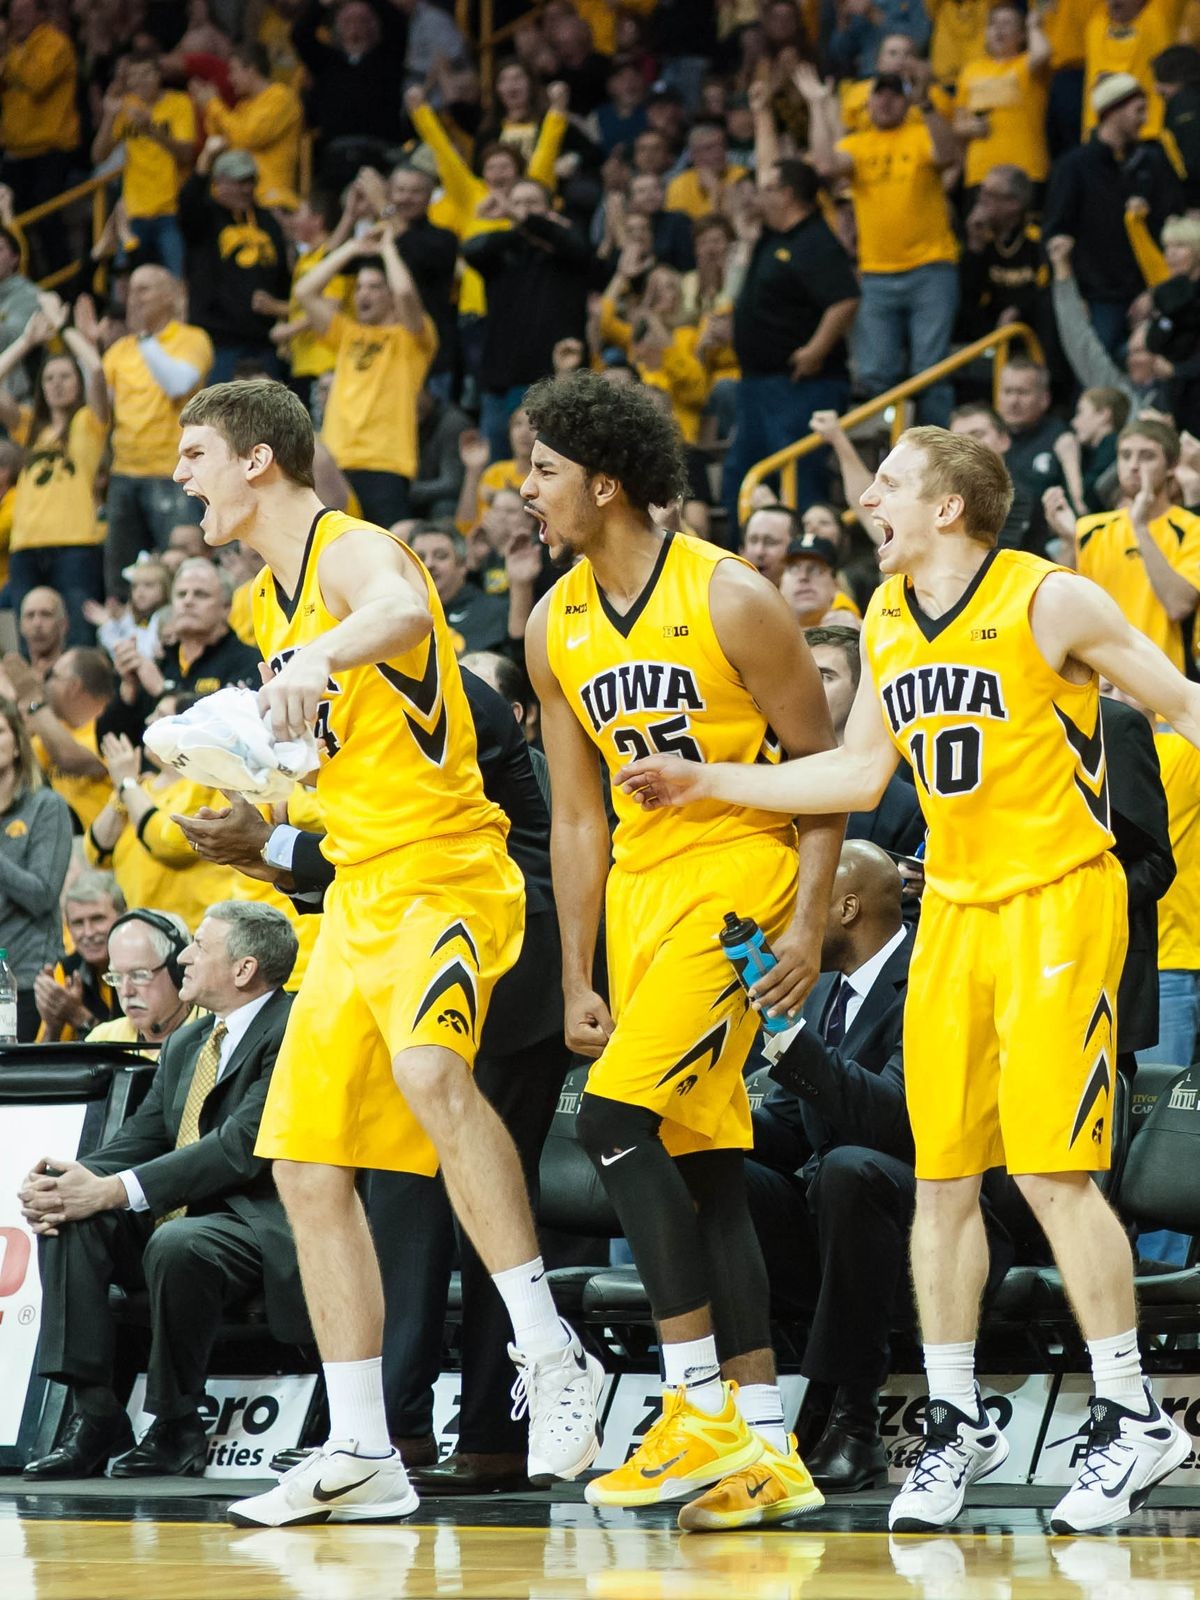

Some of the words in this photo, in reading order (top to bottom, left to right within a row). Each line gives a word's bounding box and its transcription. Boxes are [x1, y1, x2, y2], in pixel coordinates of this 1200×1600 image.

[579, 662, 706, 734] IOWA
[881, 664, 1008, 737] IOWA
[909, 723, 983, 798] 10
[197, 1394, 280, 1436] ero
[206, 1440, 265, 1467] ities
